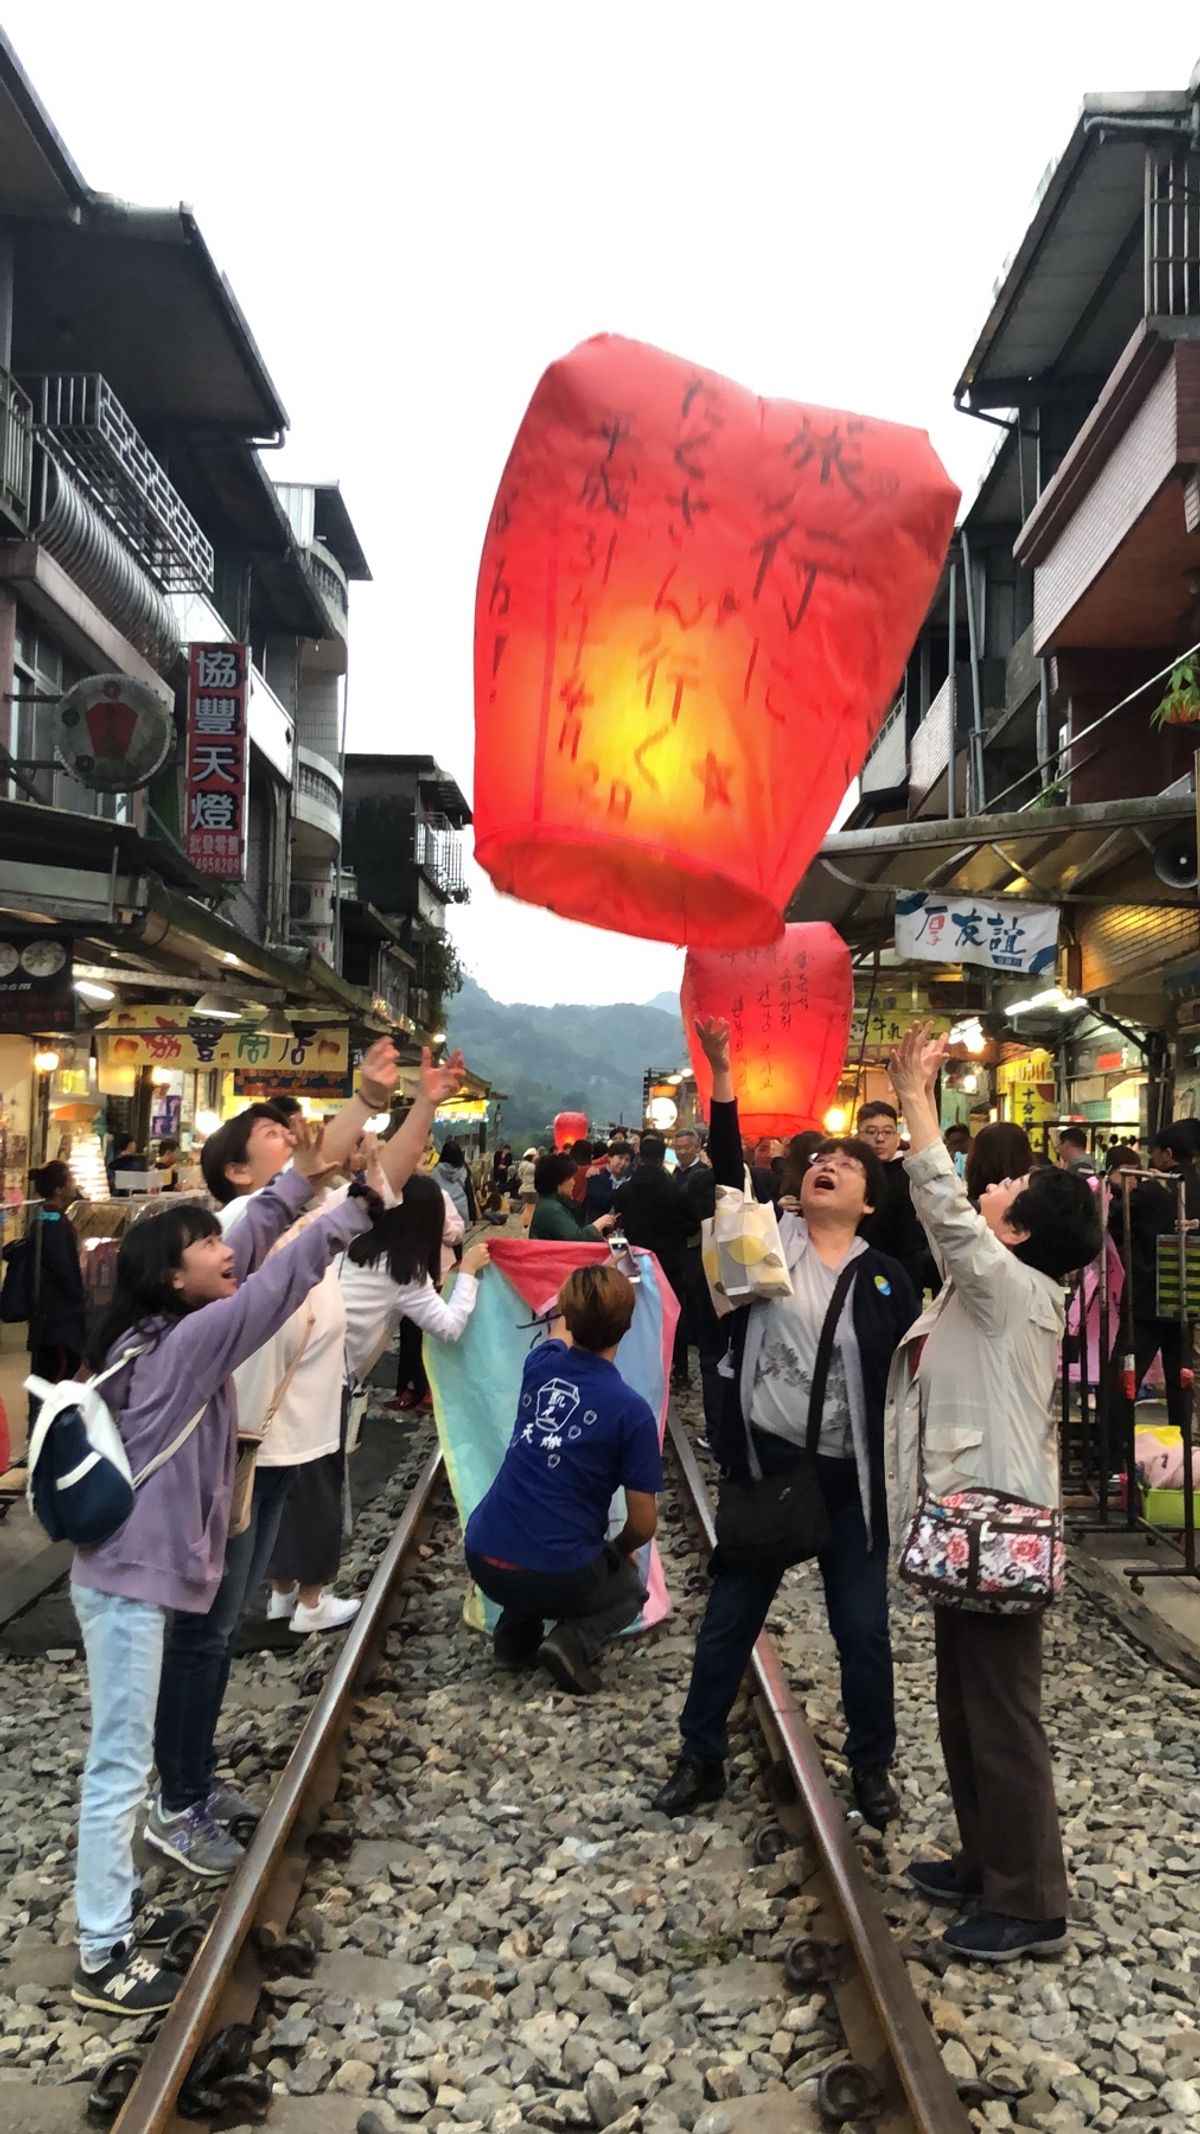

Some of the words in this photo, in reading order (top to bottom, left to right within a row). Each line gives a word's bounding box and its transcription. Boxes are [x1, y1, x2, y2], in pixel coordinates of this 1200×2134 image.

[191, 650, 238, 830] 協豐天燈
[915, 904, 1027, 955] 厚友誼
